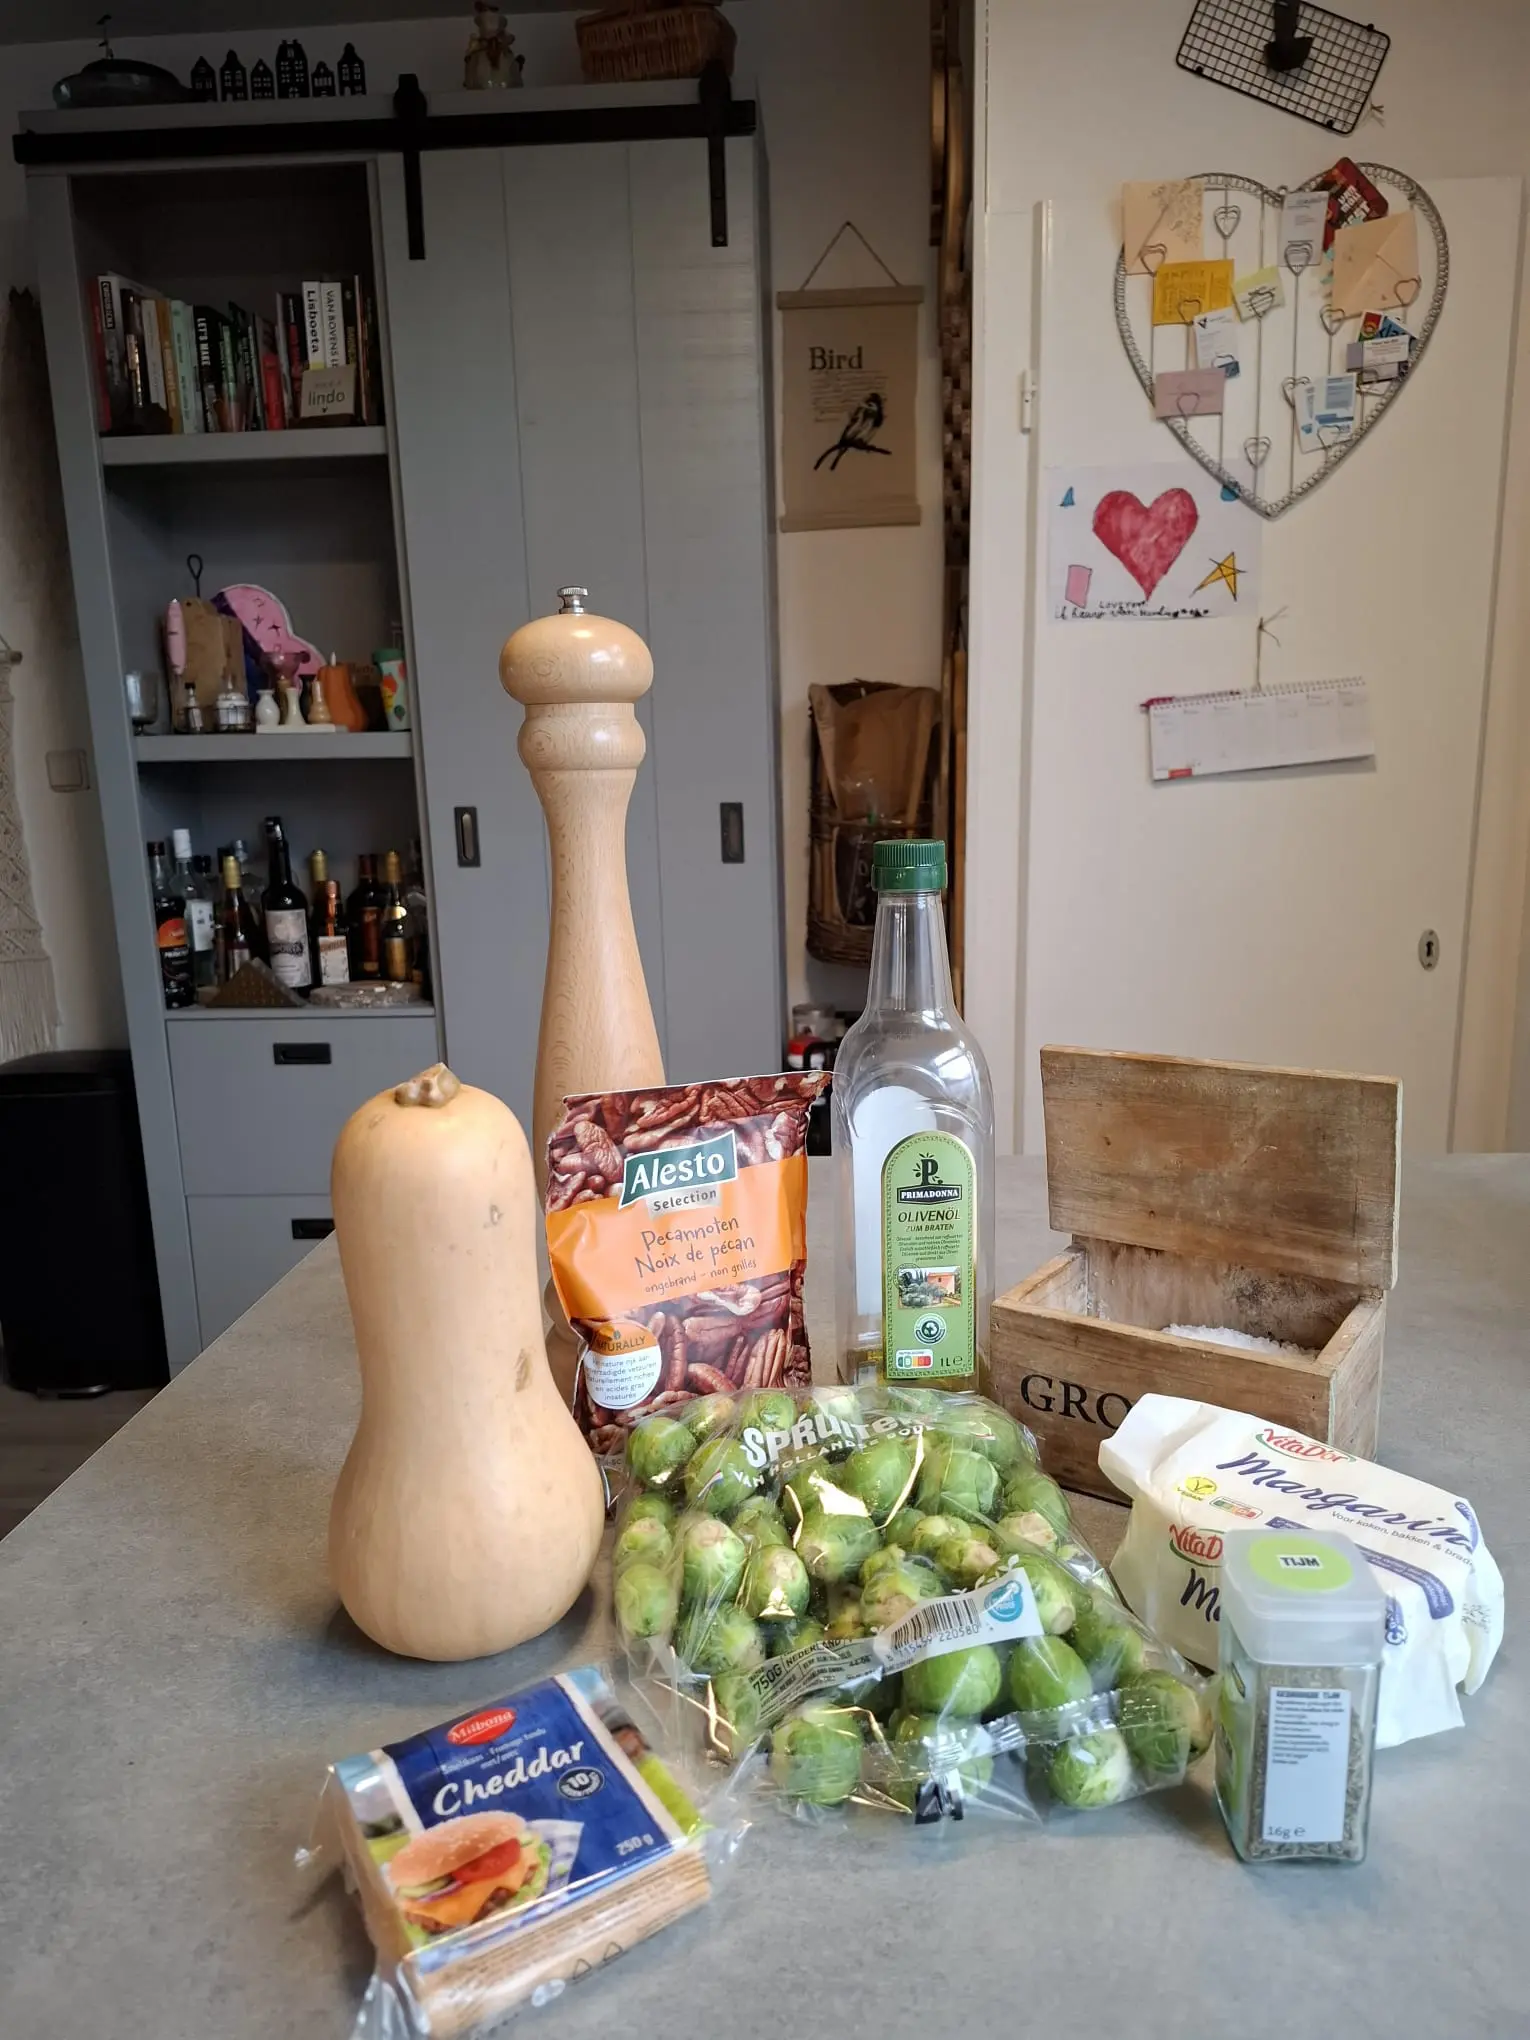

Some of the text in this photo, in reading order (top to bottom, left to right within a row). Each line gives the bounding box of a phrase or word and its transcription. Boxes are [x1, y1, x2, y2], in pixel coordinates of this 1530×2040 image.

[326, 289, 336, 312] VAN
[307, 289, 320, 353] Lisboeta
[808, 345, 863, 371] Bird
[308, 390, 345, 406] lindo
[631, 1151, 725, 1194] Alesto
[653, 1188, 717, 1212] Selection
[901, 1189, 959, 1199] PRIMADONNA
[898, 1207, 960, 1223] OLIVENÖL
[924, 1223, 955, 1232] BRATEN
[641, 1216, 739, 1251] Pecannoten
[635, 1237, 755, 1278] Noix de pécan
[645, 1272, 697, 1294] ongebrand
[710, 1267, 729, 1279] non
[597, 1335, 646, 1352] TURALLY
[1262, 1428, 1348, 1464] VitaD'or
[732, 1469, 765, 1488] VAN
[770, 1438, 879, 1477] HOLLANDE
[1216, 1451, 1476, 1555] Margarin
[1169, 1523, 1223, 1560] VitaD
[1329, 1510, 1475, 1567] Voor koken, bakken & brad
[1280, 1556, 1321, 1568] TIJM
[939, 1623, 980, 1643] 220580
[753, 1663, 783, 1696] 750G
[451, 1709, 515, 1742] Milbona
[432, 1740, 585, 1816] Cheddar
[567, 1772, 591, 1788] 10
[1267, 1824, 1291, 1839] 16g
[615, 1835, 643, 1856] 250
